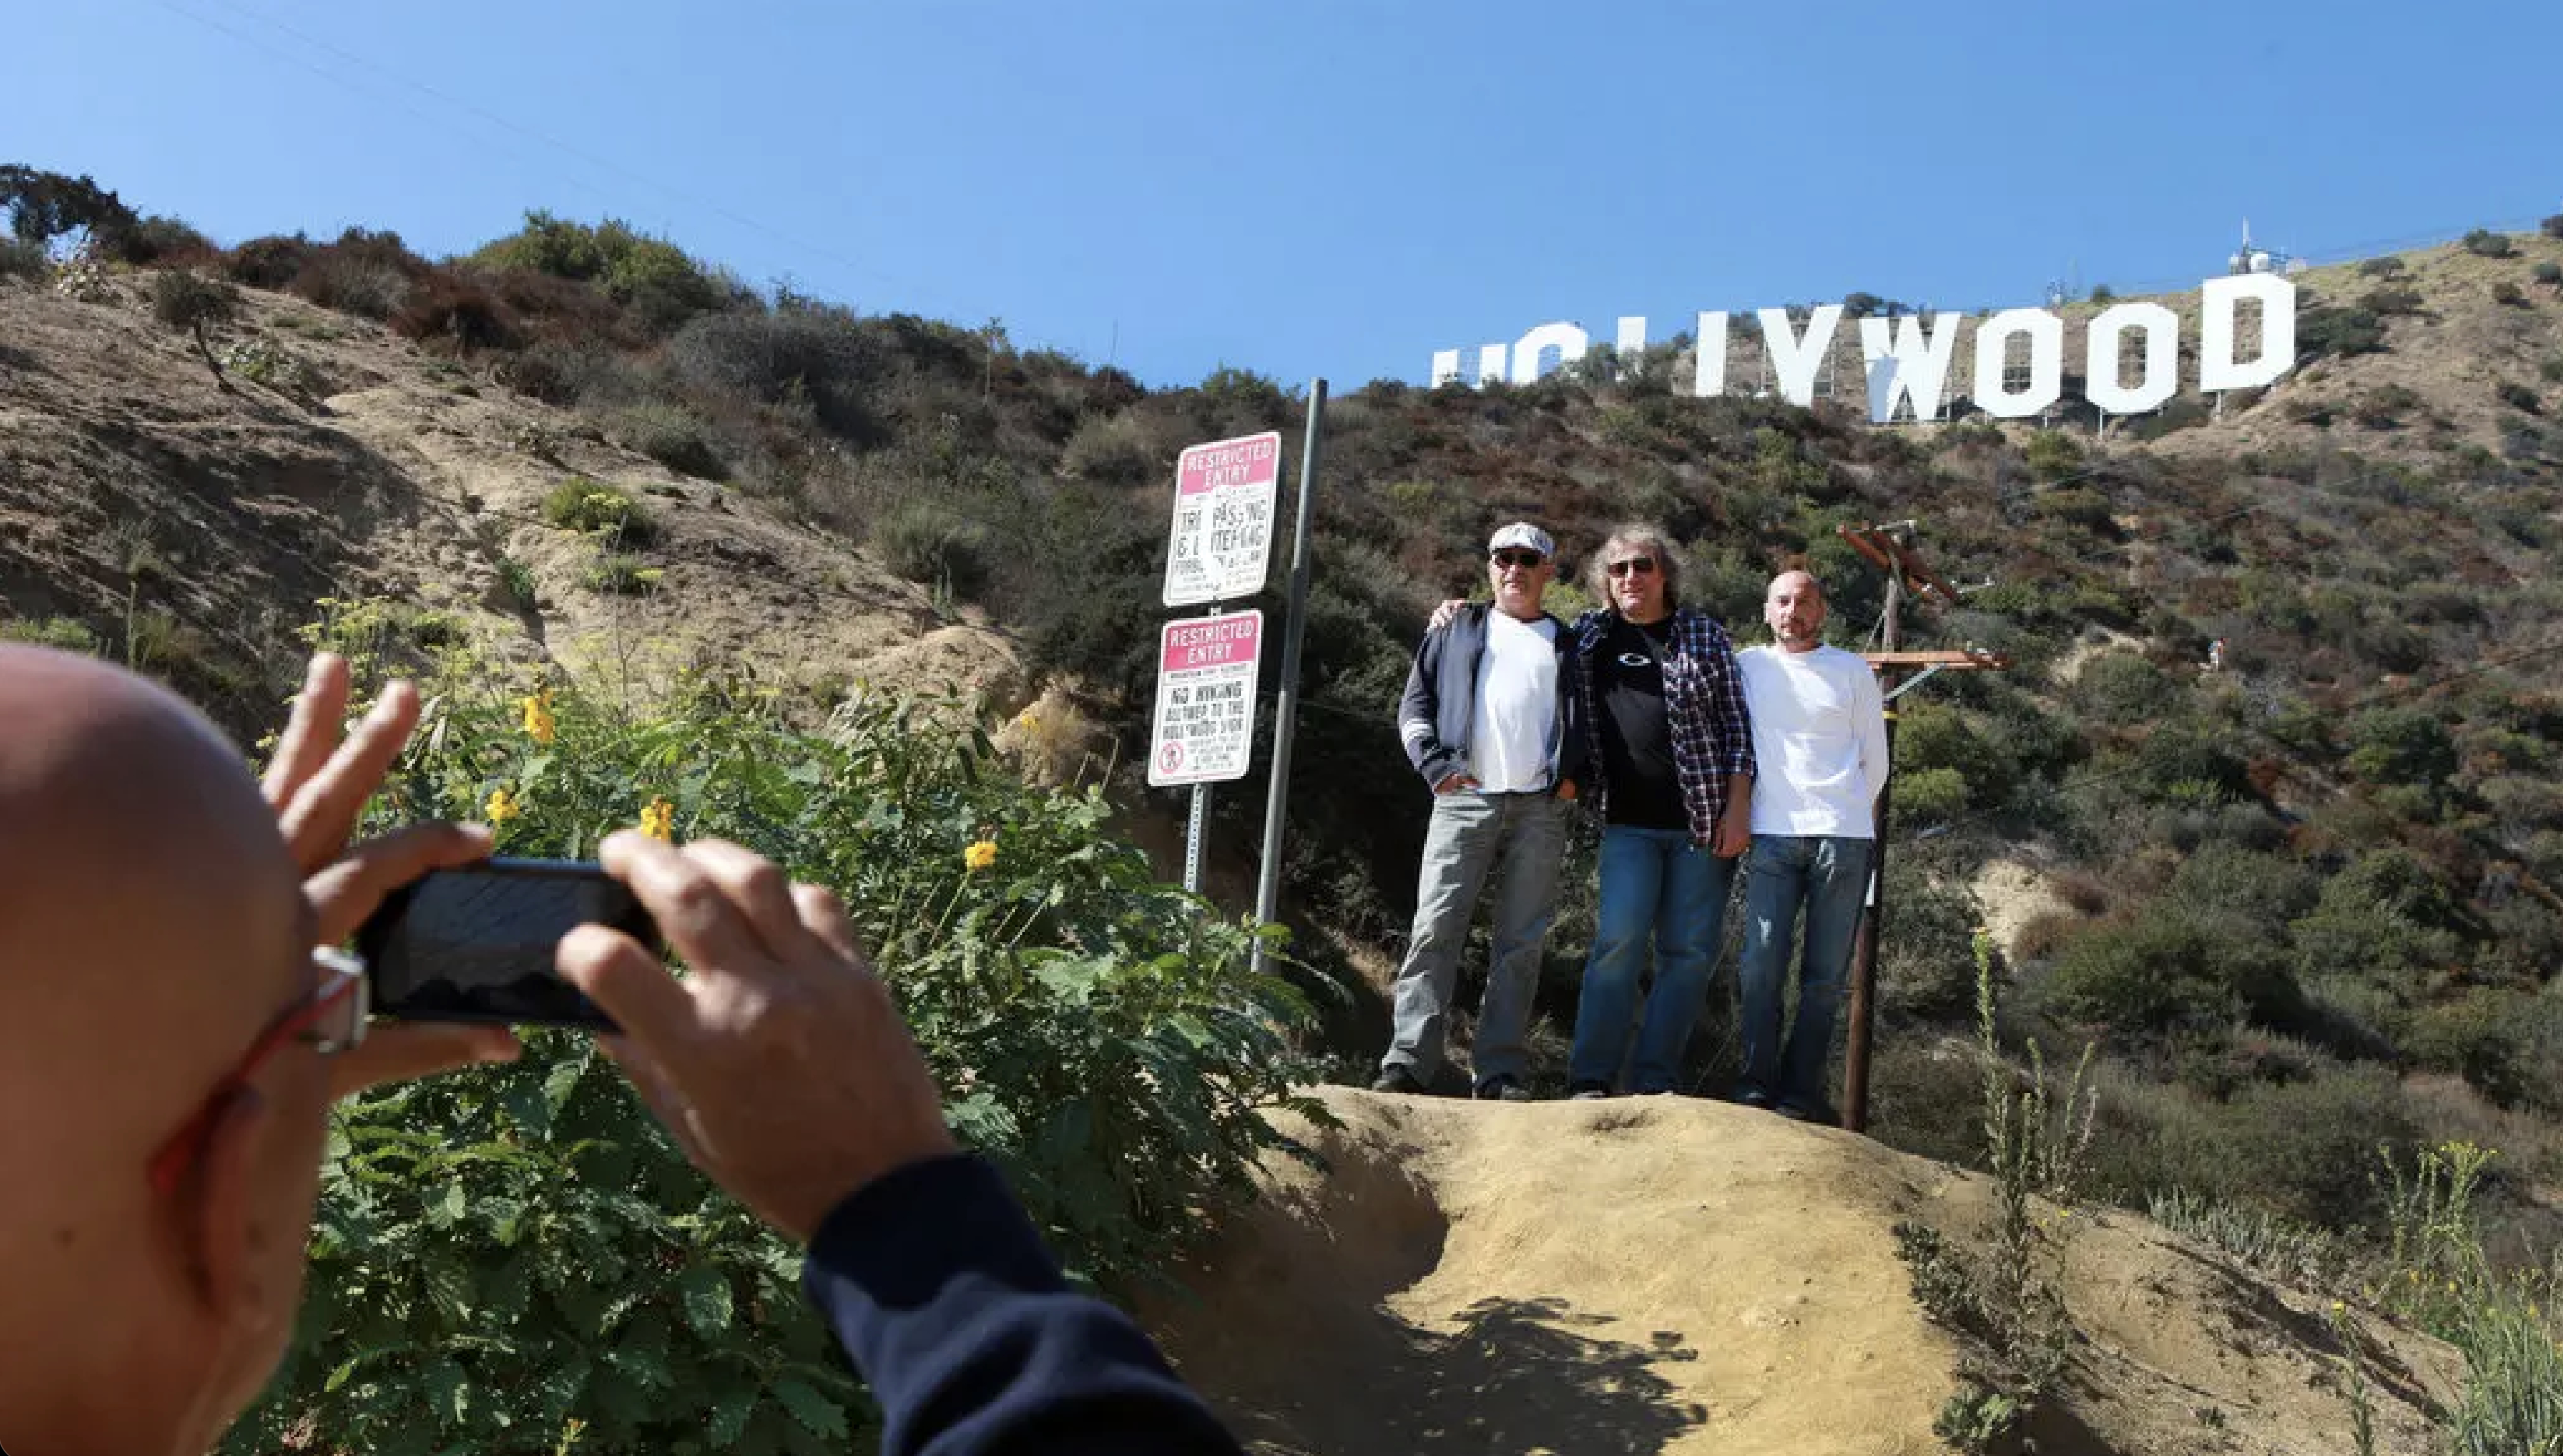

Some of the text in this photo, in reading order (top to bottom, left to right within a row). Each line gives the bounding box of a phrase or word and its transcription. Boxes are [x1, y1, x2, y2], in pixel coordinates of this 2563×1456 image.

[1186, 442, 1273, 471] RESTRICTED
[1204, 464, 1251, 487] ENTRY
[1180, 498, 1267, 532] TRPASSNG
[1192, 525, 1264, 556] LITERING
[1170, 622, 1254, 647] RESTRICTED
[1188, 642, 1234, 664] ENTRY
[1170, 680, 1243, 704] NO HIKING
